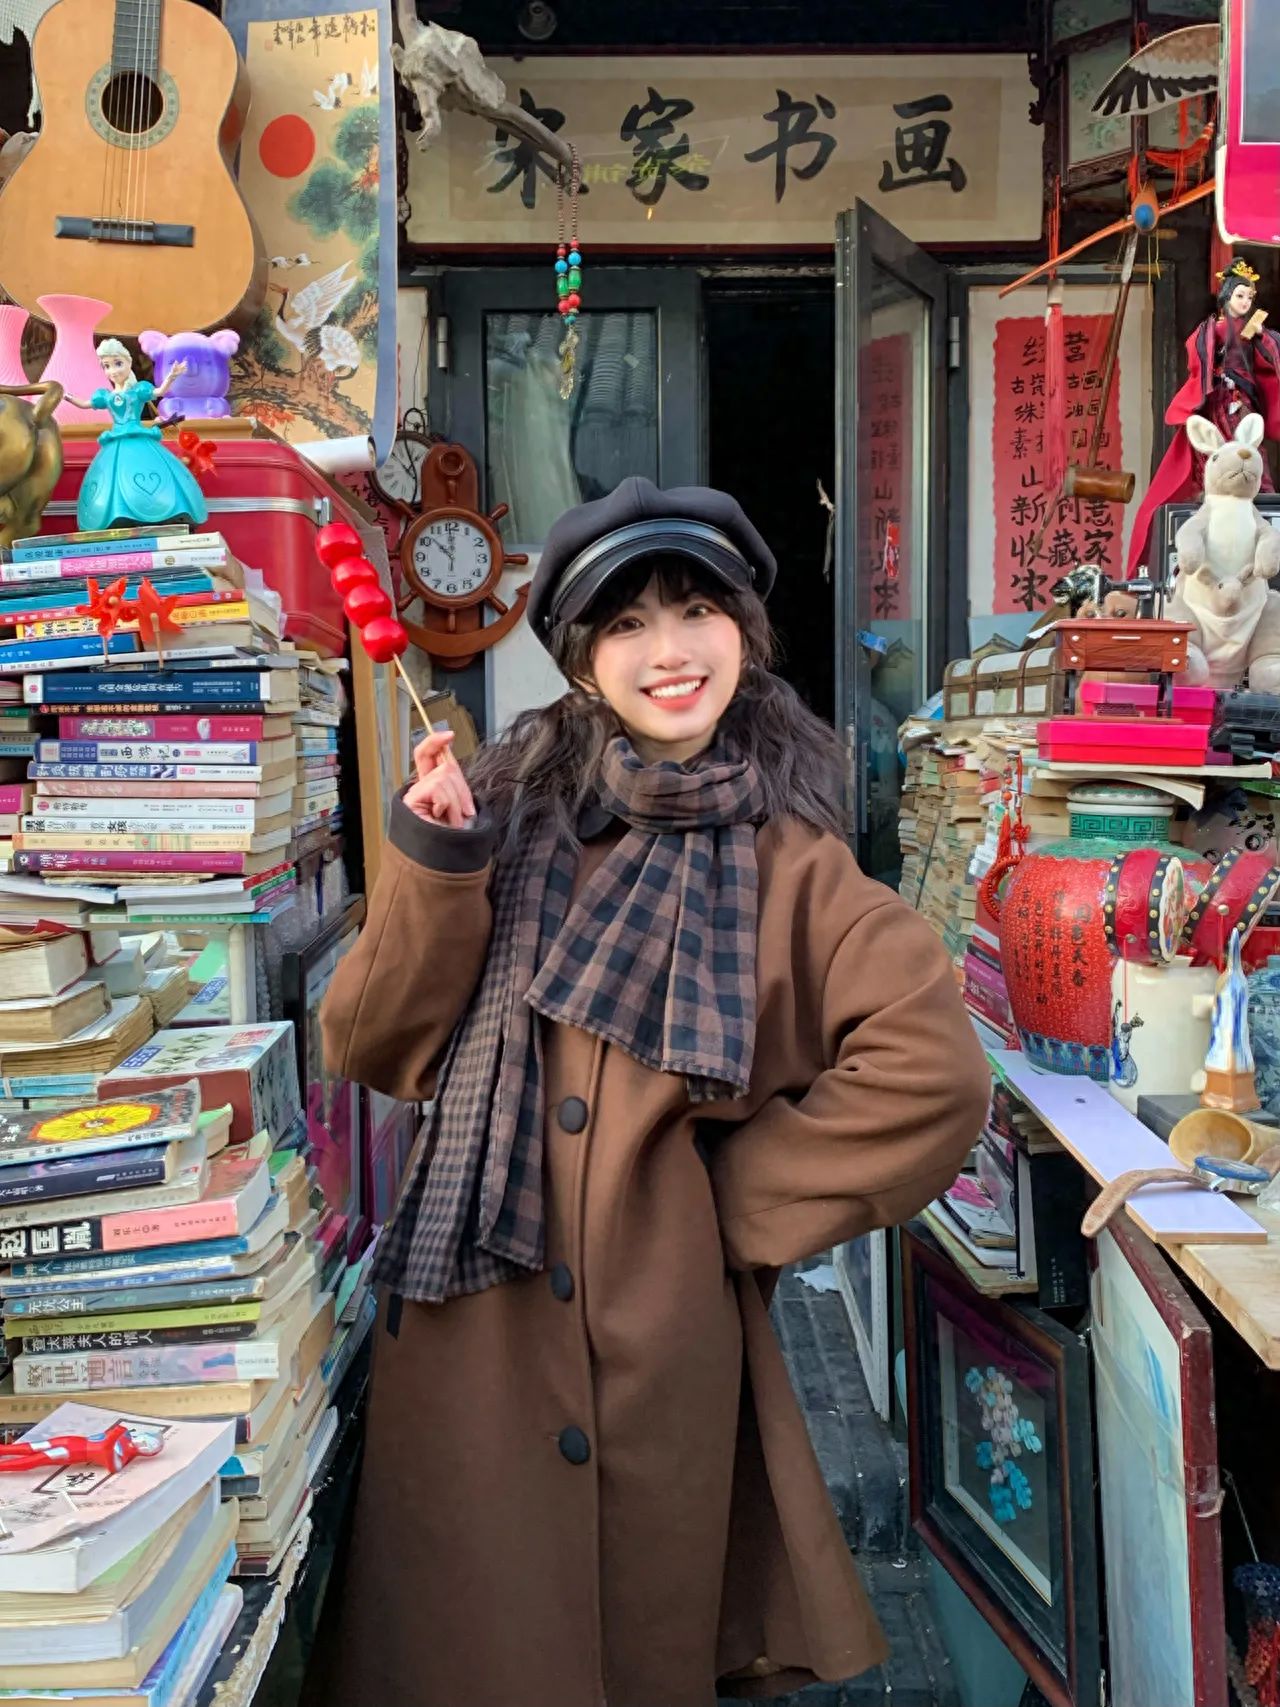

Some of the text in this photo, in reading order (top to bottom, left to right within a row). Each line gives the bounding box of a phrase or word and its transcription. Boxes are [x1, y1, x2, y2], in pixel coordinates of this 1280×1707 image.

[487, 86, 968, 209] 宋家书画
[445, 522, 459, 531] 12
[420, 536, 431, 546] 10
[474, 537, 484, 546] 2
[416, 552, 425, 561] 9
[477, 554, 487, 562] 3
[421, 567, 430, 576] 8
[433, 579, 441, 588] 7
[447, 584, 457, 592] 6
[120, 743, 171, 761] 西游记
[28, 1297, 87, 1314] 无忧公主
[28, 1359, 133, 1388] 警世通言
